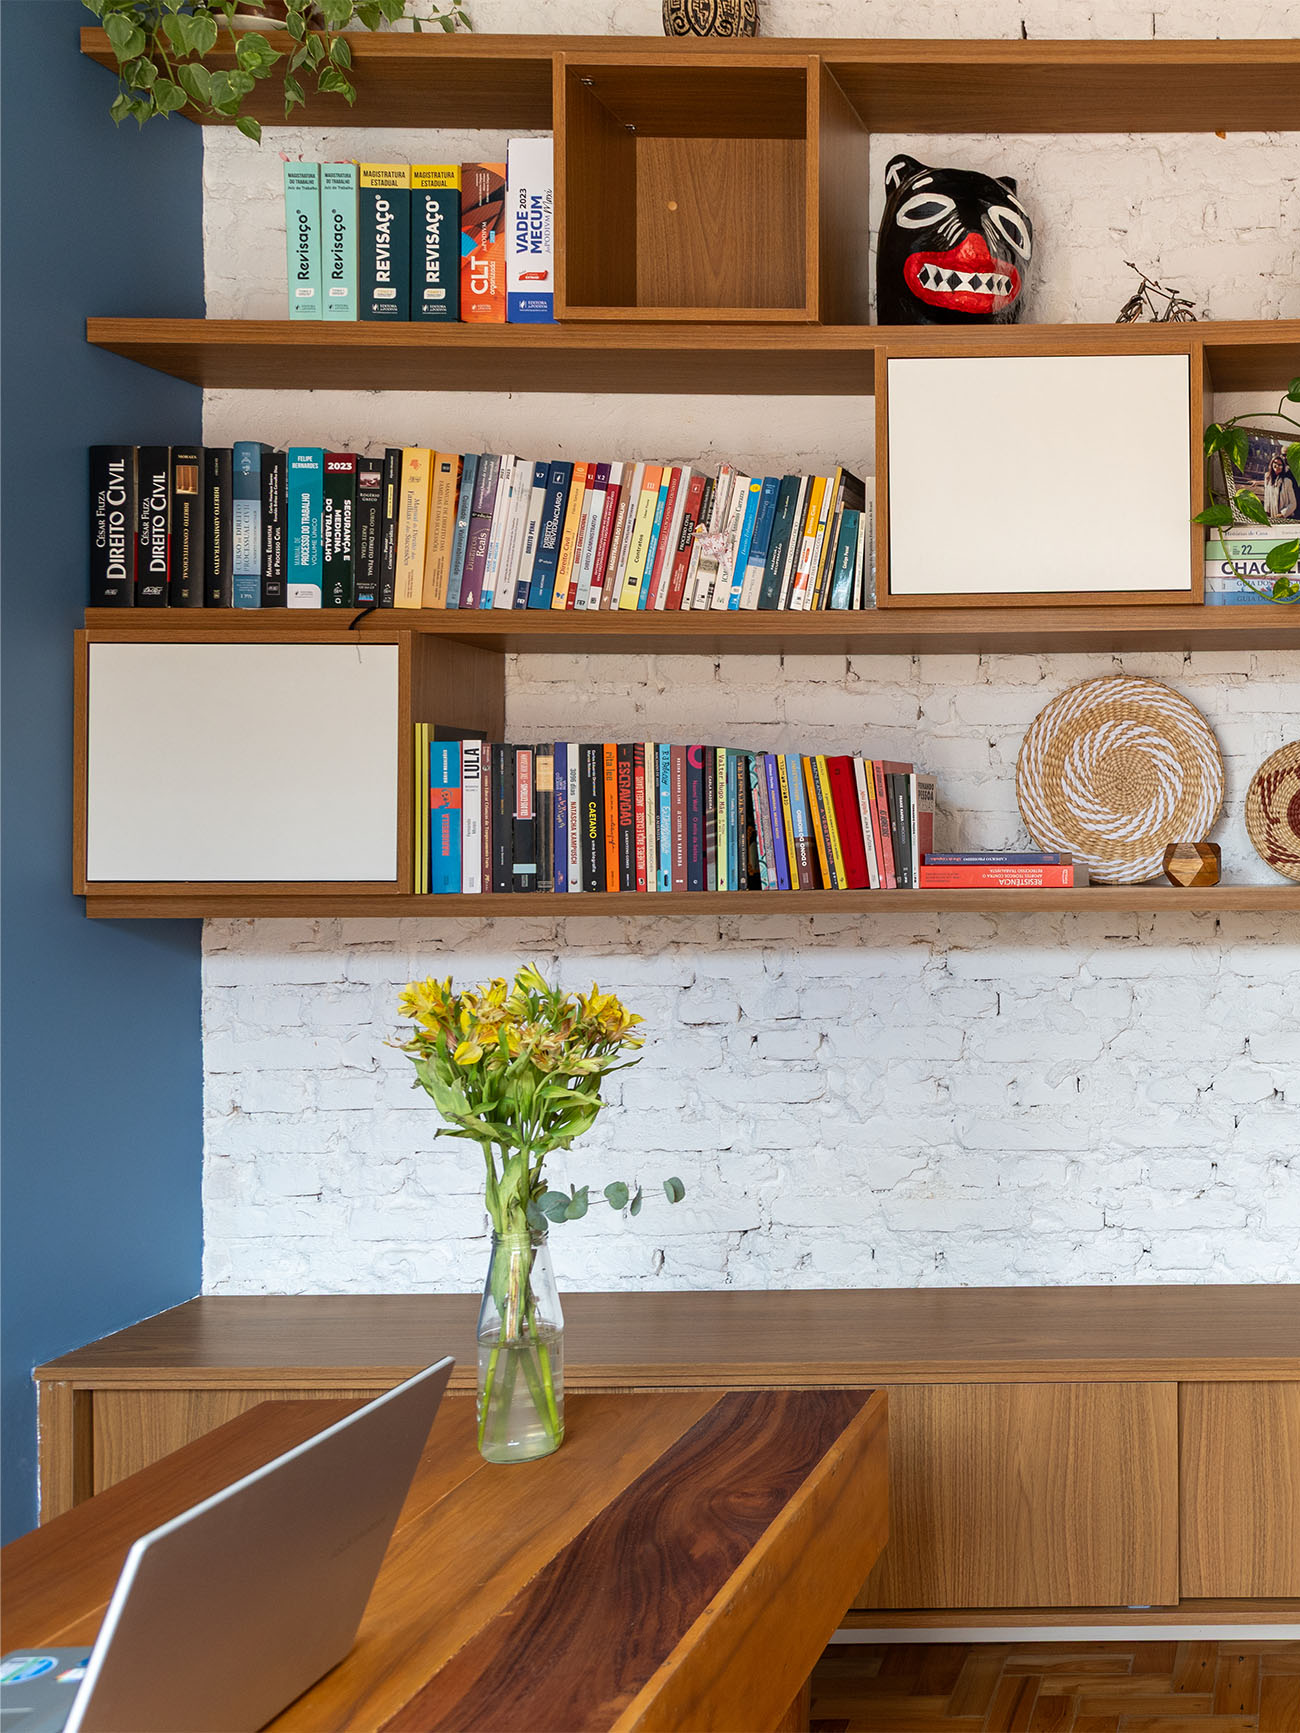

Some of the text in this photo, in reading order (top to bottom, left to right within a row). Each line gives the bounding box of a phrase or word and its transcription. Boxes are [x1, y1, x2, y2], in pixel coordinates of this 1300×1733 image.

[363, 170, 405, 178] MAGISTRATURA
[370, 179, 398, 187] ESTADUAL
[516, 188, 529, 254] VADE 2023
[531, 196, 543, 254] MECUM
[296, 214, 311, 280] Revisaço
[331, 214, 345, 279] Revisaço
[375, 200, 394, 282] REVISAÇO
[425, 200, 443, 282] REVISAÇO
[471, 256, 489, 295] CLT
[328, 462, 352, 470] 2023
[96, 491, 106, 548] CÉSAR FIUZA
[106, 459, 126, 579] DIREITO CIVIL
[141, 498, 150, 545] CÉSAR FIUZA
[302, 493, 310, 524] TRABALHO
[325, 498, 332, 511] DO
[443, 507, 449, 515] DE
[549, 492, 563, 549] PREVIDENCIÁRIO
[150, 472, 166, 572] DIREITO CIVIL
[342, 499, 351, 553] SEGURANÇA
[433, 520, 441, 552] SUCESSÕES
[454, 495, 469, 575] Cuidado & Vulnerabilidade
[526, 520, 536, 554] DIREITO PENAL
[543, 520, 553, 548] DIREITO
[577, 513, 587, 547] CONSTITUCIONAL
[609, 535, 621, 571] MAGISTRATURA
[615, 502, 626, 528] TRABALHO
[679, 527, 688, 551] PROCESSO
[301, 534, 310, 566] PROCESSO
[467, 536, 477, 571] DIREITOS
[476, 532, 488, 557] Reais
[584, 515, 597, 570] DIREITO ADMINISTRATIVO
[634, 534, 644, 563] Contratos
[773, 543, 783, 575] RECUPERAÇÃO
[1241, 545, 1252, 555] 22
[464, 748, 479, 779] LULA
[605, 752, 615, 781] rita lee
[636, 776, 644, 807] ANGELA DAVIS
[781, 784, 789, 806] GEORGE
[442, 814, 450, 856] MARIGHELLA
[588, 802, 597, 839] CAETANO
[796, 810, 804, 832] MORRO
[798, 833, 805, 841] DO
[821, 816, 833, 865] VEGETARIANA
[999, 878, 1043, 886] RESISTÊNCIA
